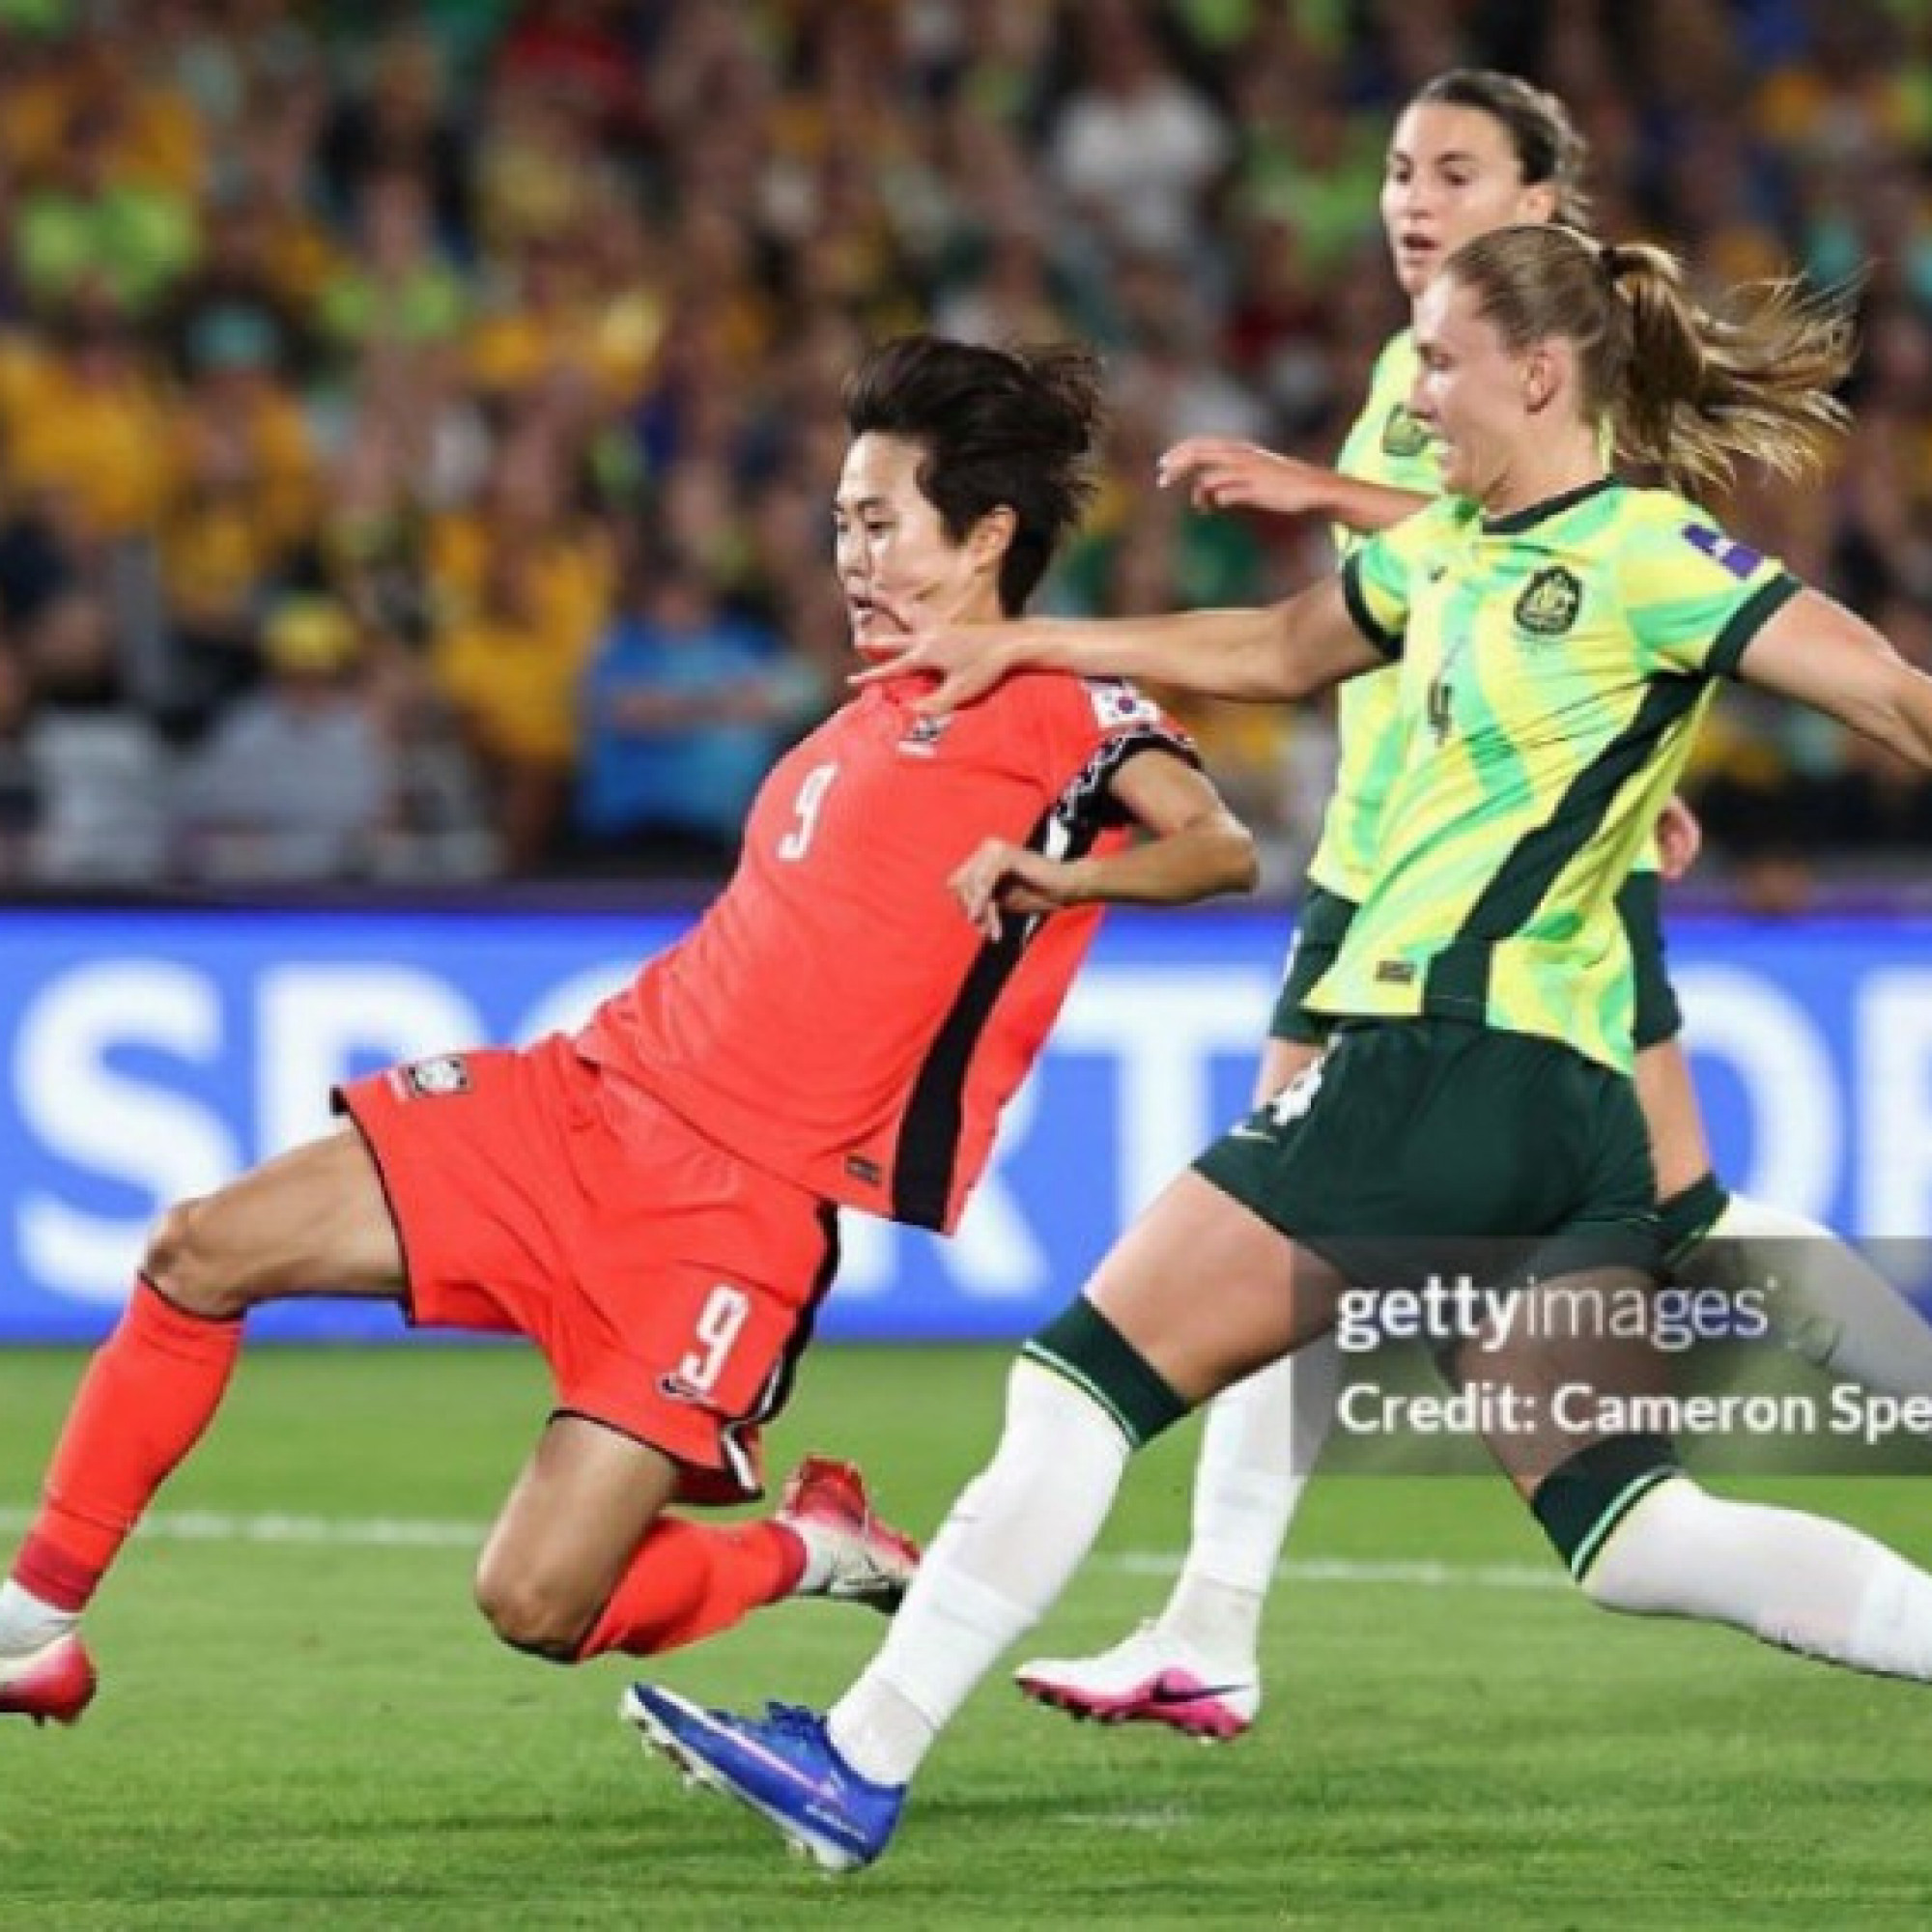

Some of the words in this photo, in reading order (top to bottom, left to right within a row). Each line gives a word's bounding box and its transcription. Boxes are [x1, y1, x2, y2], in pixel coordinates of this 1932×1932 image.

[776, 761, 839, 862] 9
[10, 959, 1277, 1300] SPT
[678, 1283, 751, 1392] 9
